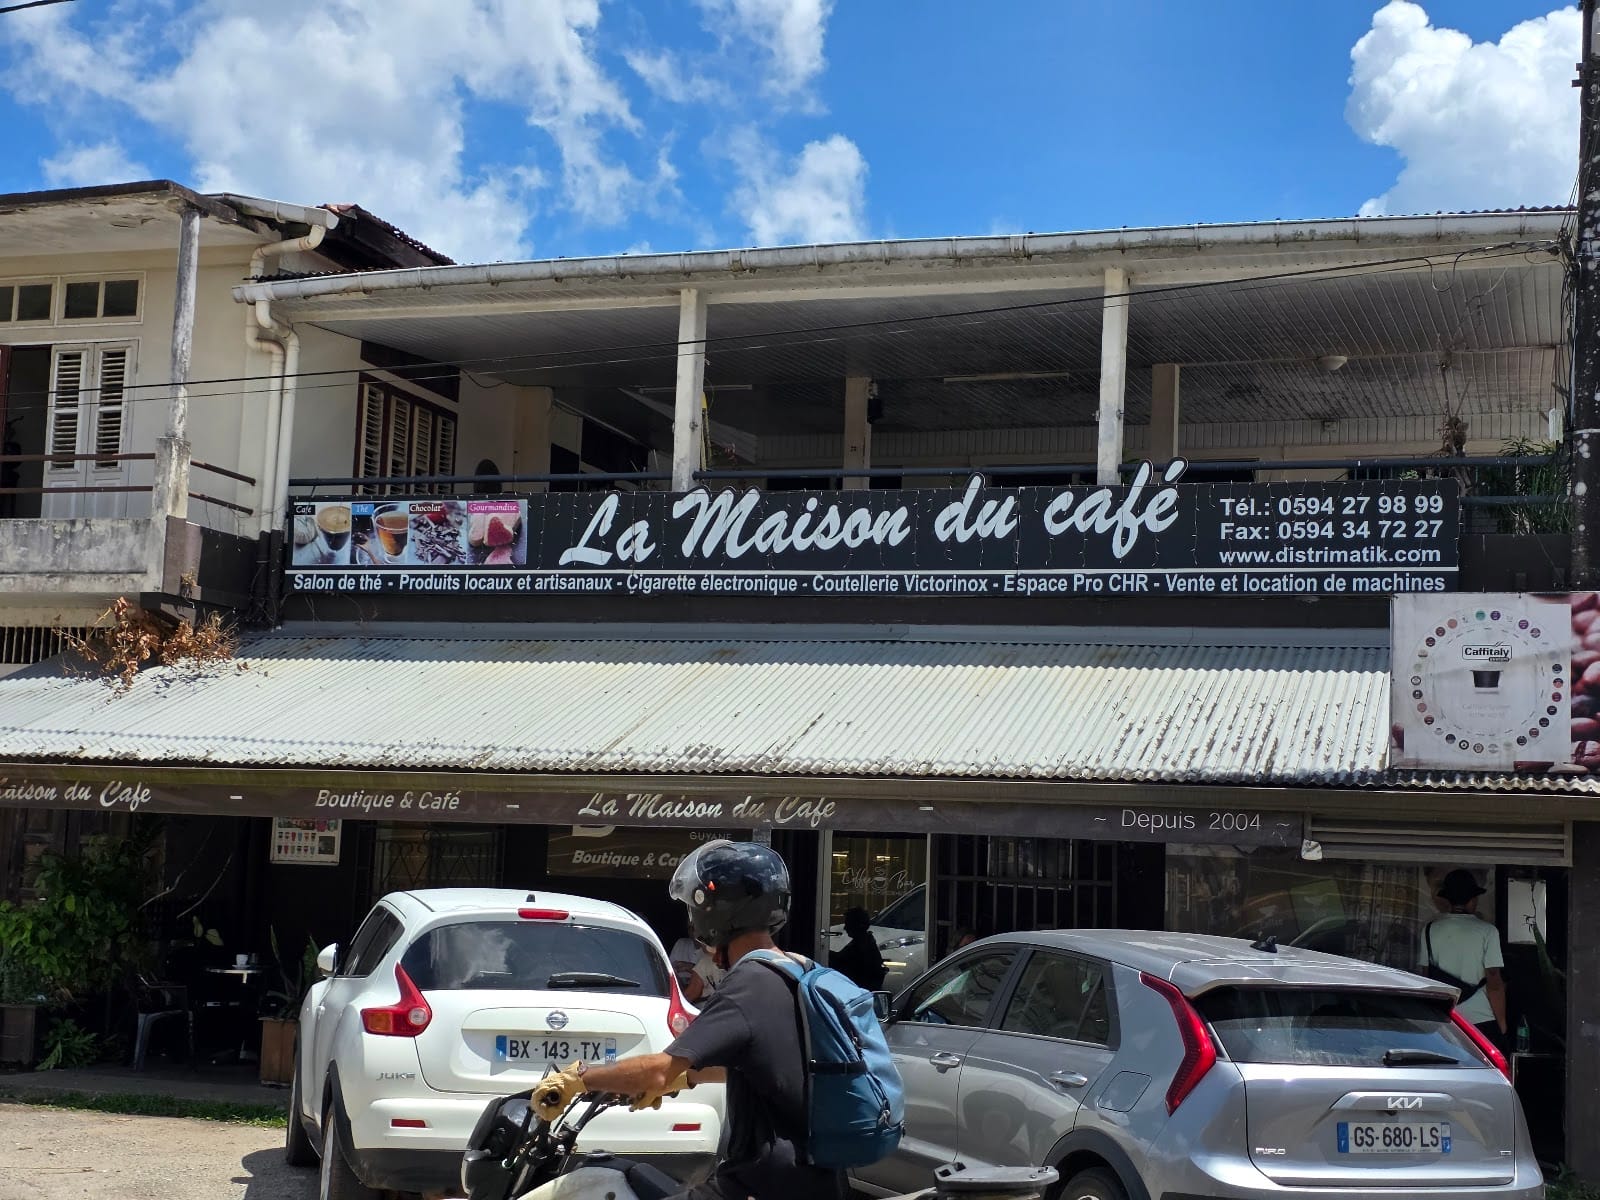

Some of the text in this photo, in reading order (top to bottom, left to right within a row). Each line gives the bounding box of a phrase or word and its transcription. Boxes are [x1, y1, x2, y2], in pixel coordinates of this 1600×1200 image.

[295, 504, 313, 514] Café
[409, 503, 442, 513] Chocolat
[469, 503, 518, 513] Gourmandise
[558, 460, 1185, 566] La Maison du café
[1219, 494, 1444, 516] Tél.: 0594 27 98 99
[1219, 519, 1444, 541] Fax: 0594 34 72 27
[1219, 545, 1441, 564] www.distrimatik.com
[293, 574, 334, 591] Salon
[337, 574, 356, 591] de
[359, 573, 382, 591] thé
[399, 574, 461, 591] Produits
[464, 574, 513, 591] locaux
[516, 575, 532, 591] et
[534, 574, 612, 592] artisanaux
[626, 574, 697, 595] Cigarette
[700, 573, 798, 596] électronique
[812, 574, 899, 592] Coutellerie
[904, 574, 988, 592] Victorinox
[1004, 574, 1068, 596] Espace
[1073, 574, 1103, 592] Pro
[1108, 574, 1149, 592] CHR
[1165, 574, 1216, 592] Vente
[1220, 574, 1238, 592] et
[1243, 573, 1319, 592] location
[1323, 573, 1346, 592] de
[1352, 572, 1446, 592] machines
[1464, 646, 1509, 658] Caffitaly
[64, 781, 92, 802] du
[314, 789, 395, 813] Boutique
[399, 791, 413, 809] &
[418, 790, 461, 810] Café
[578, 792, 619, 817] La
[626, 793, 723, 819] Maison
[732, 795, 765, 818] du
[1121, 808, 1196, 833] Depuis
[1208, 812, 1262, 831] 2004
[689, 831, 732, 841] GUYANE
[571, 849, 641, 867] Boutique
[643, 852, 655, 867] &
[375, 1072, 417, 1081] JUKE
[1353, 1126, 1440, 1148] GS-680-LS
